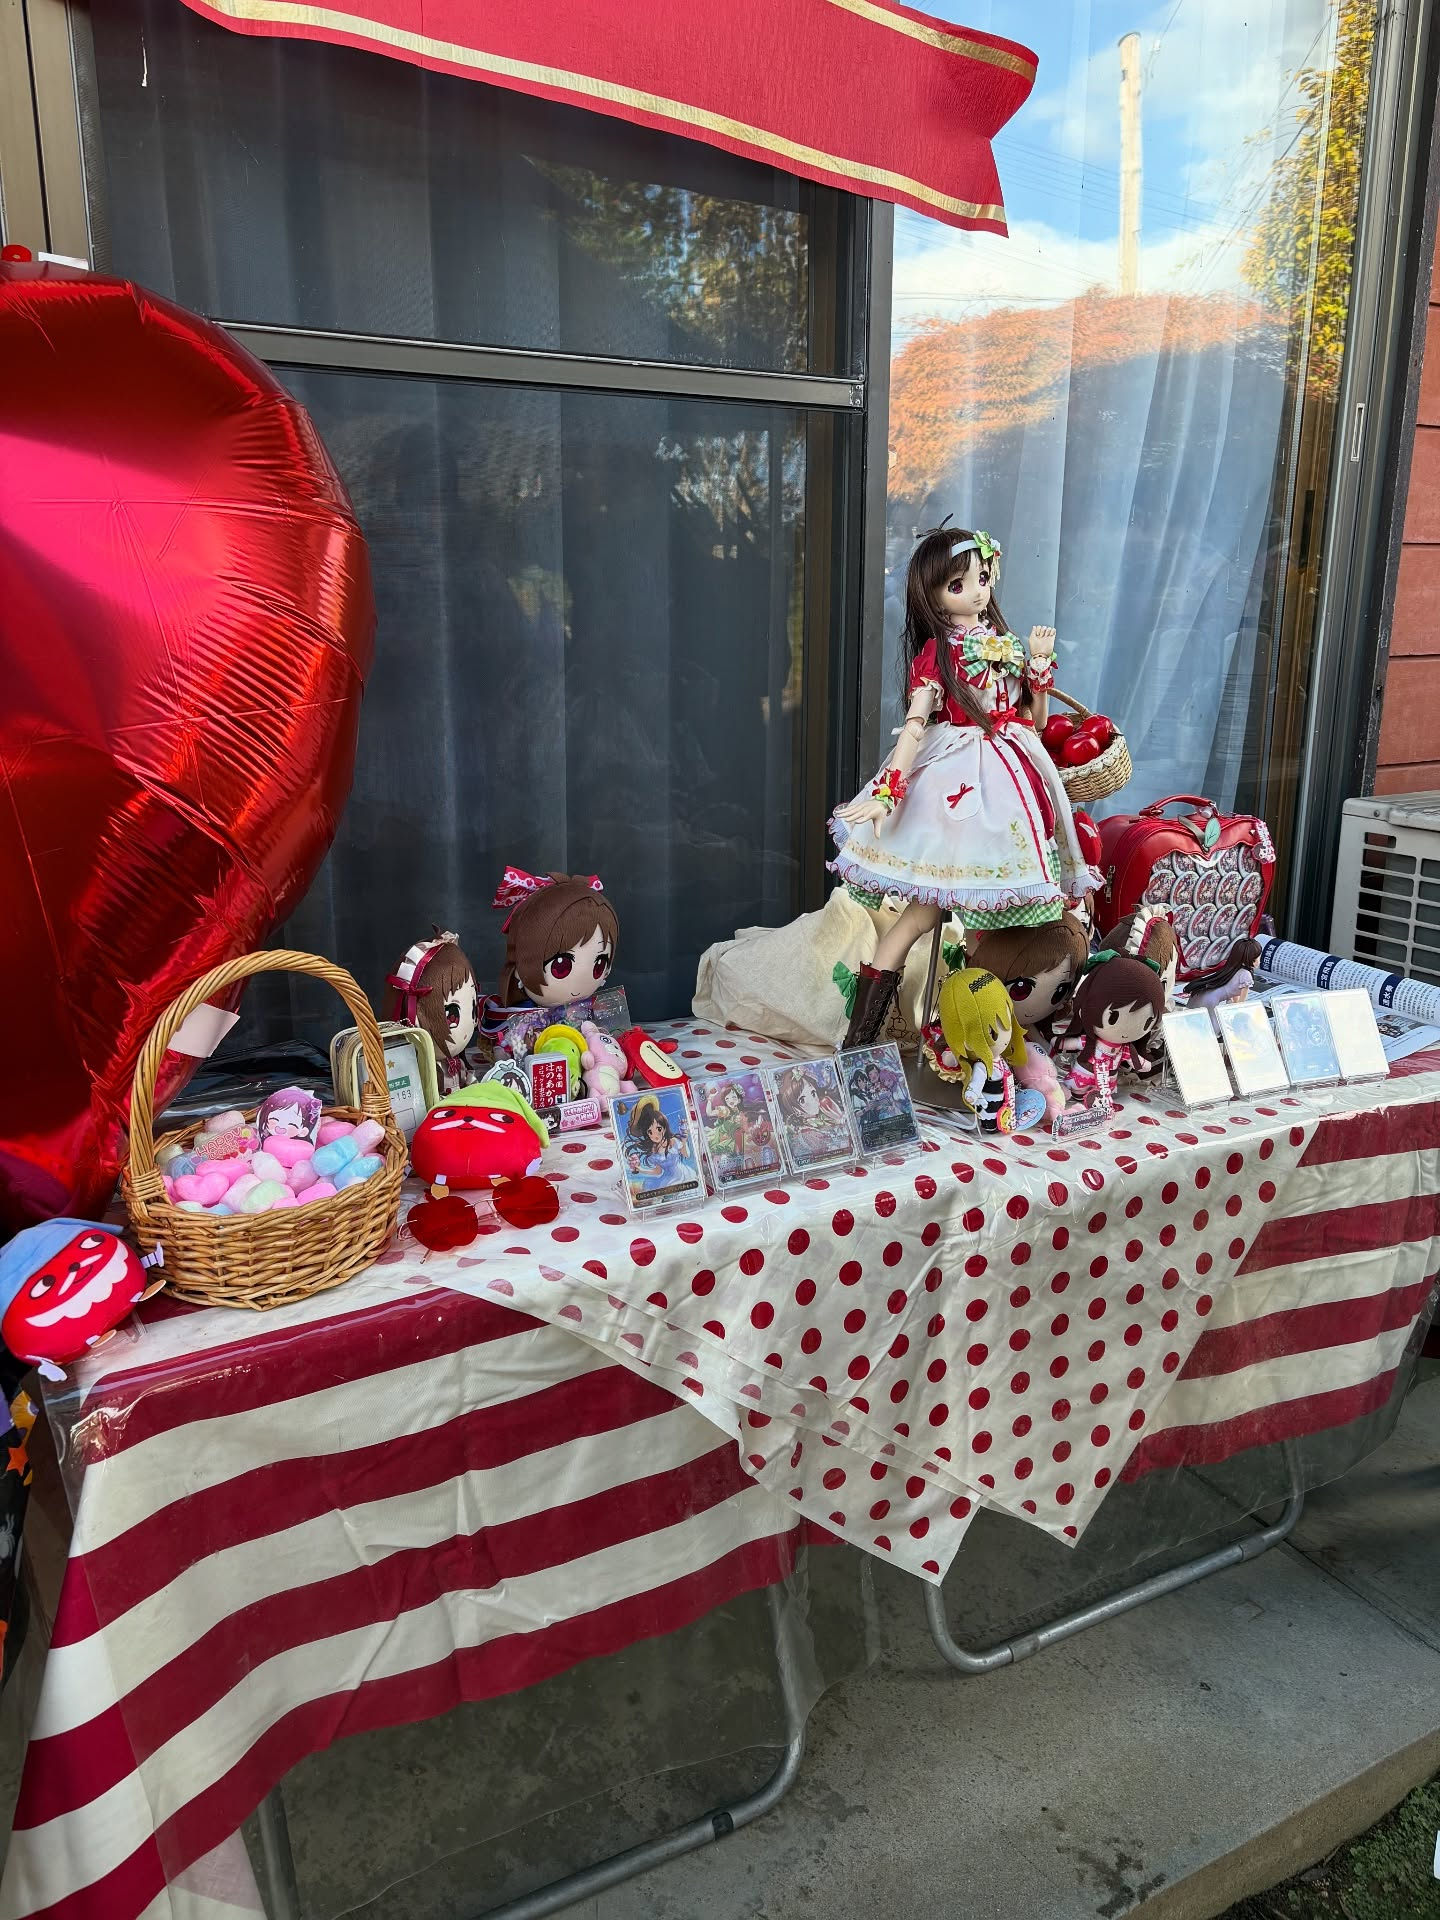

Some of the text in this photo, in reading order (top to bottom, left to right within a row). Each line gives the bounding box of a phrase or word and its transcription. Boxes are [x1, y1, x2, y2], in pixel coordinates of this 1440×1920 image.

[1319, 960, 1335, 988] 二宮飛鳥
[545, 1062, 556, 1106] 辻のあかり
[195, 1126, 242, 1158] HAPPY
